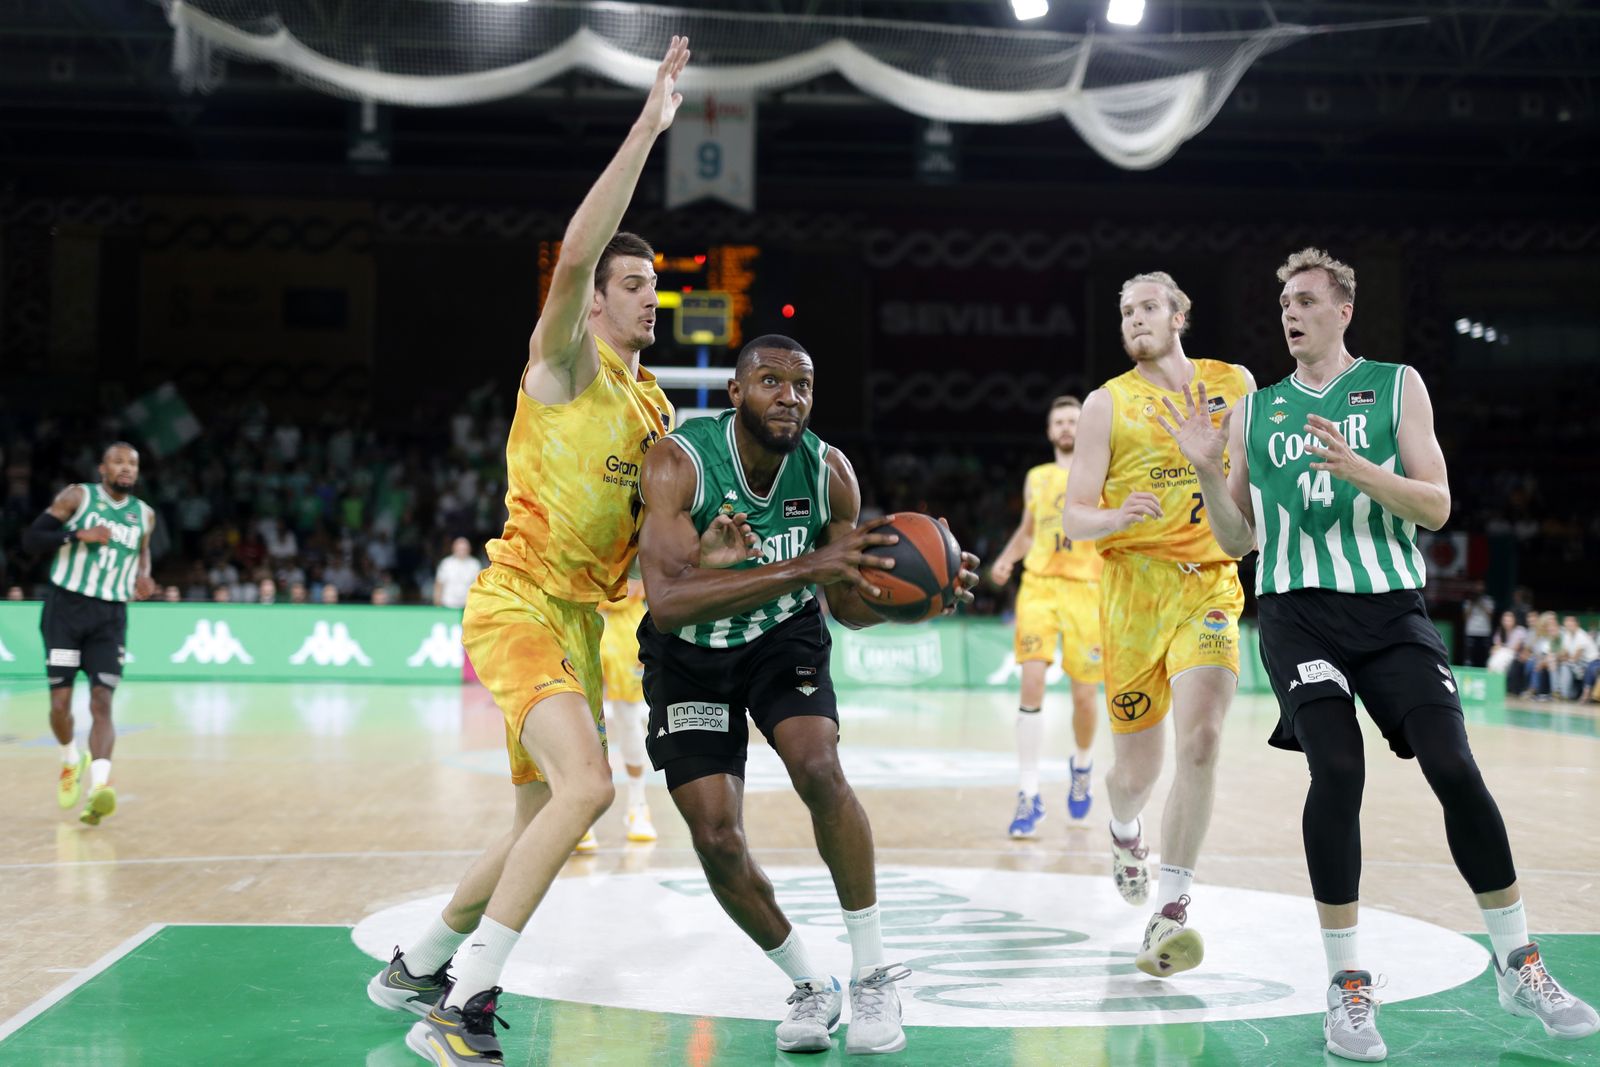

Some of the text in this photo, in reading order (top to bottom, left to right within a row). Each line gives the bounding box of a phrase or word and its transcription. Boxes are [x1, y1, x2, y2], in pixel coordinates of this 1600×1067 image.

[698, 142, 721, 180] 9
[880, 302, 1075, 337] SEVILLA
[602, 473, 619, 485] Isla
[1151, 481, 1166, 489] Isla
[1296, 469, 1335, 511] 14
[98, 546, 118, 571] 11
